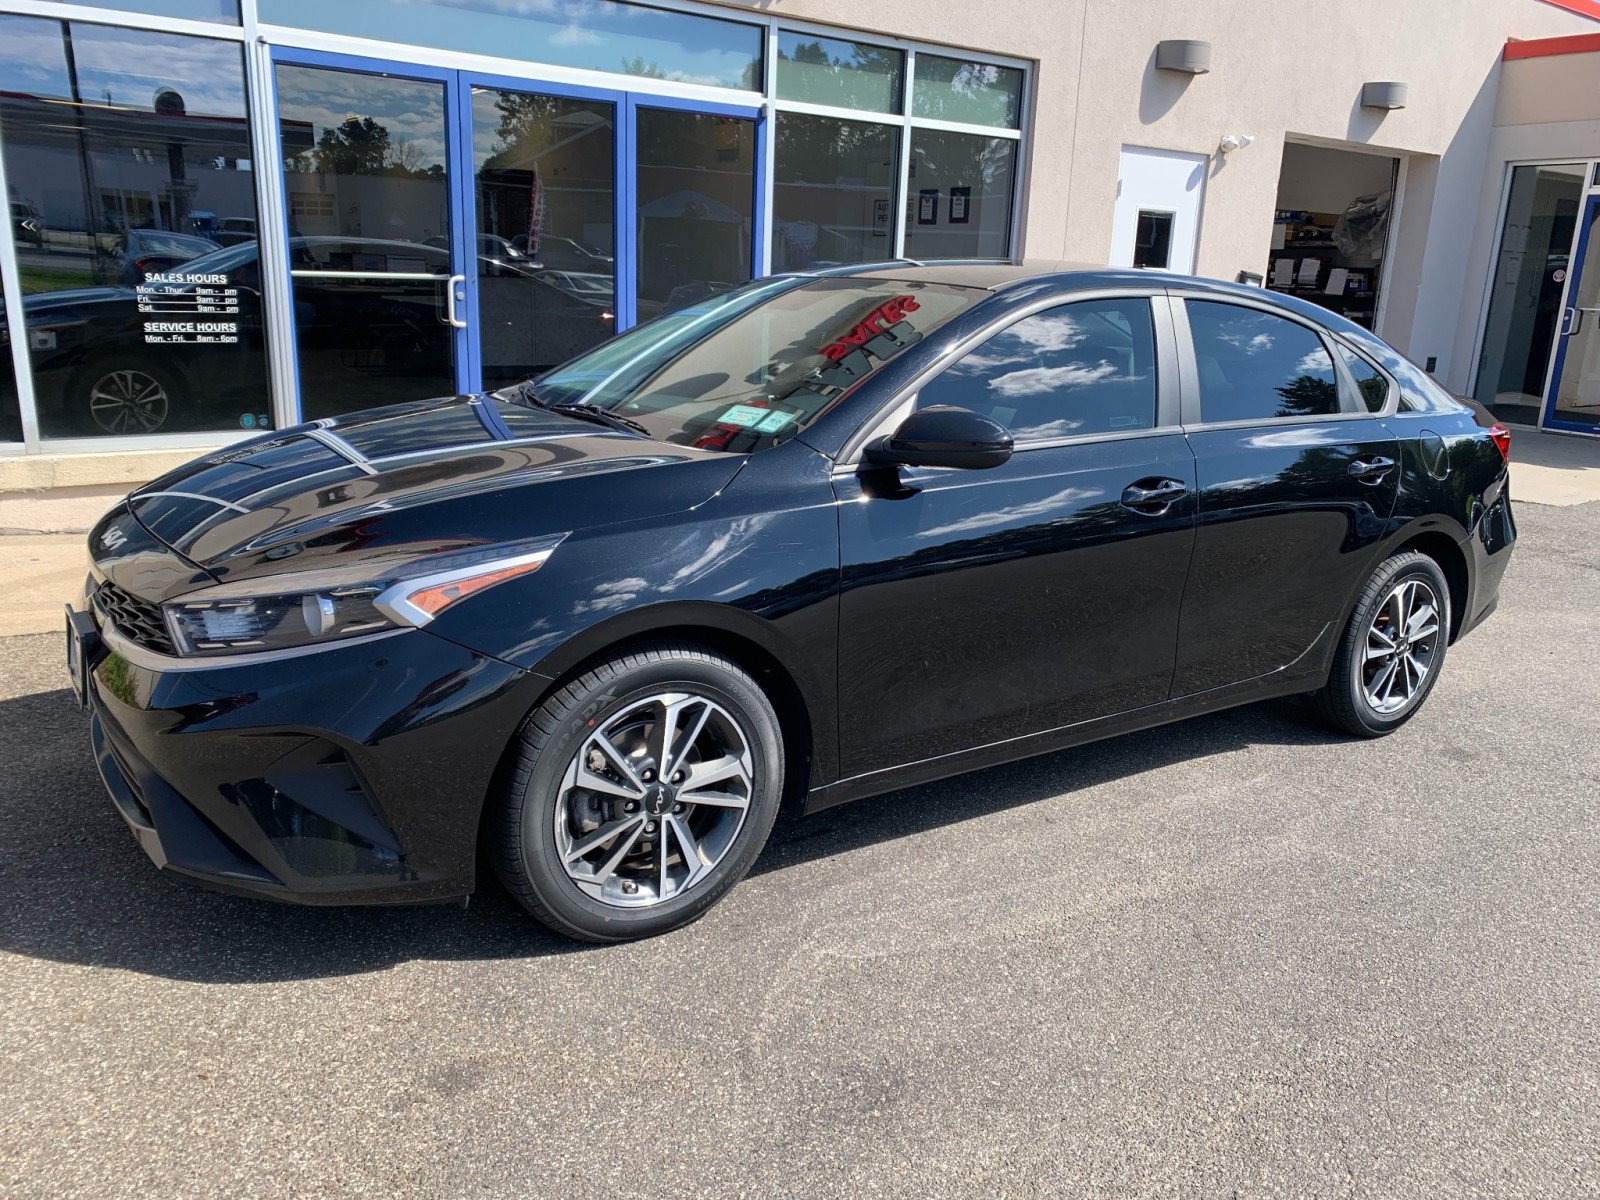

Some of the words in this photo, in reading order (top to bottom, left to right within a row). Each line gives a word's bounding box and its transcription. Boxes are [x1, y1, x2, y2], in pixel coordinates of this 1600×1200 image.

[145, 273, 183, 283] SALES
[186, 274, 227, 284] HOURS
[136, 286, 157, 294] Mon.
[164, 286, 185, 294] Thur.
[196, 287, 214, 295] 9am
[137, 295, 151, 303] Fri.
[196, 296, 214, 304] 9am
[138, 304, 155, 312] Sat.
[144, 322, 194, 331] SERVICE
[196, 322, 237, 331] HOURS
[220, 335, 238, 343] 6pm
